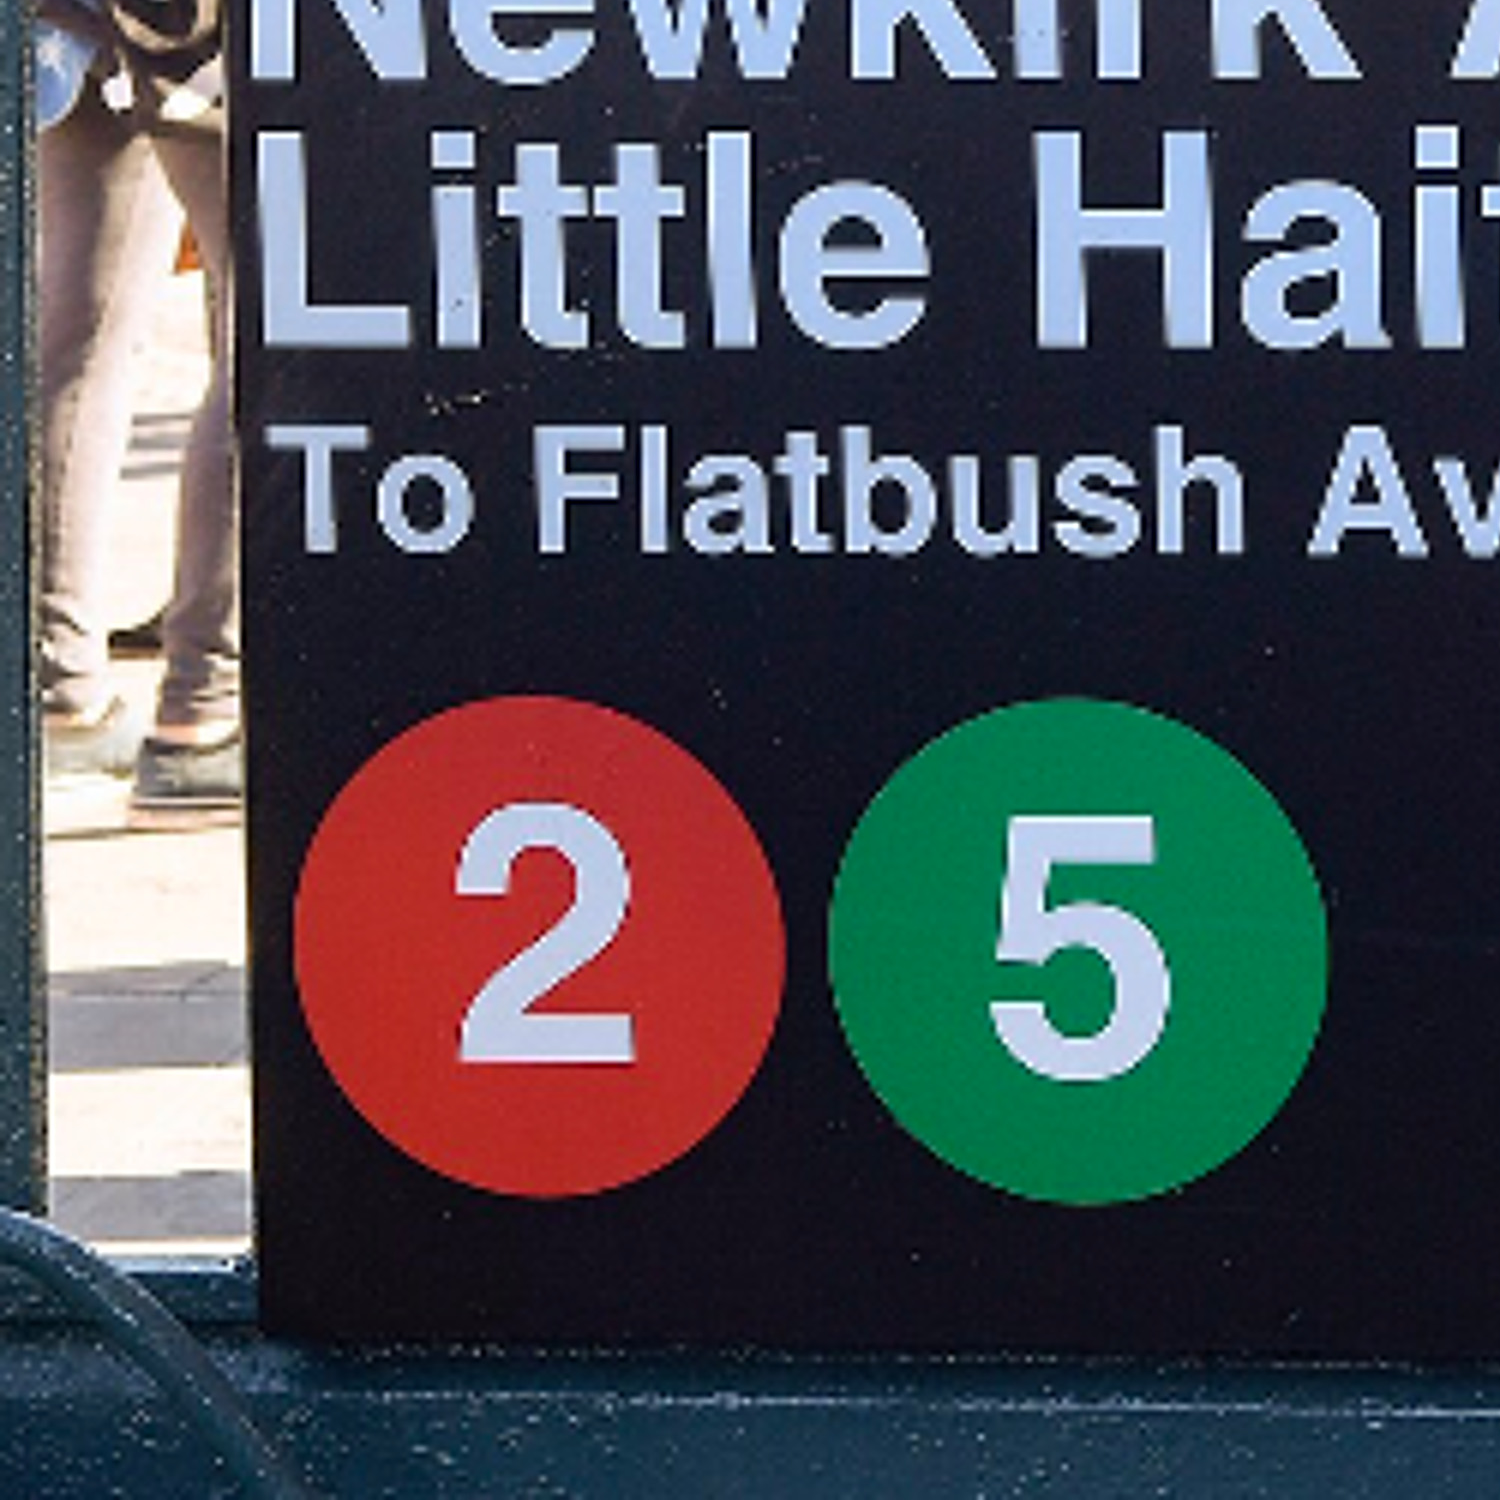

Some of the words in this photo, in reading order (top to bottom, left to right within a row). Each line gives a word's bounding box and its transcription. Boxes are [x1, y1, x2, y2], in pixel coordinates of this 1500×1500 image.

[258, 131, 929, 349] Little
[266, 426, 473, 554] To
[535, 426, 1243, 557] Flatbush
[456, 804, 635, 1063] 2
[989, 816, 1170, 1081] 5
